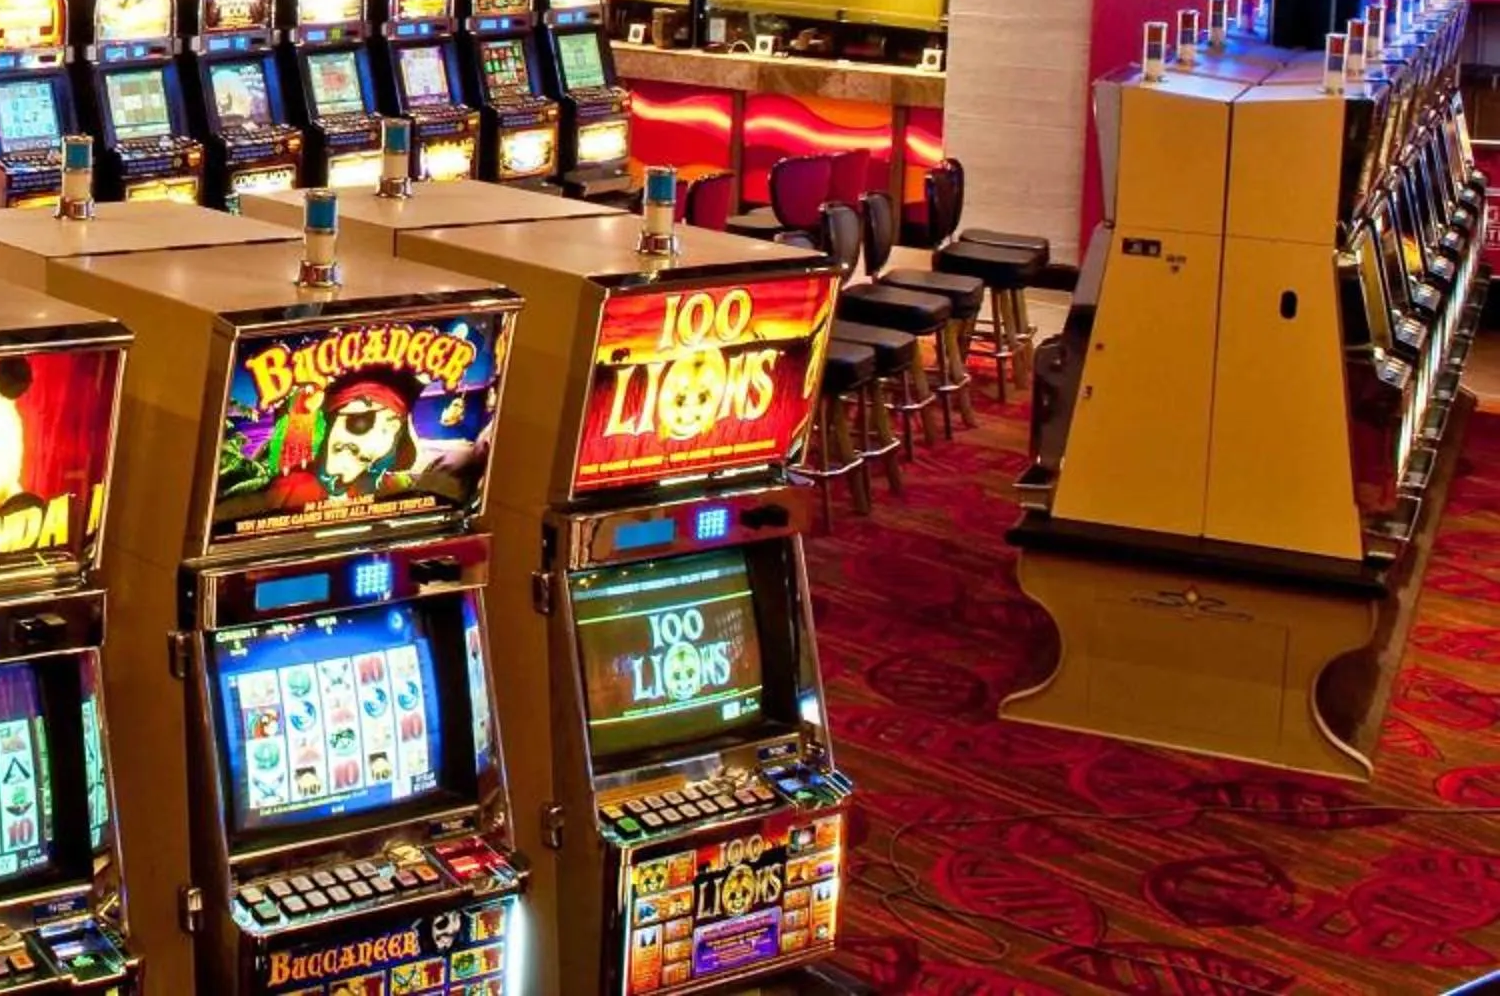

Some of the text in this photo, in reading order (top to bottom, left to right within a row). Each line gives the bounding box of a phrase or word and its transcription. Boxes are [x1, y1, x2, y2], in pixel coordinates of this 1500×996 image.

[657, 288, 753, 350] 100
[604, 346, 778, 440] LIONS
[648, 608, 704, 649] 100
[633, 641, 732, 701] LIONS
[718, 833, 764, 871] 100
[697, 863, 783, 919] LIONS
